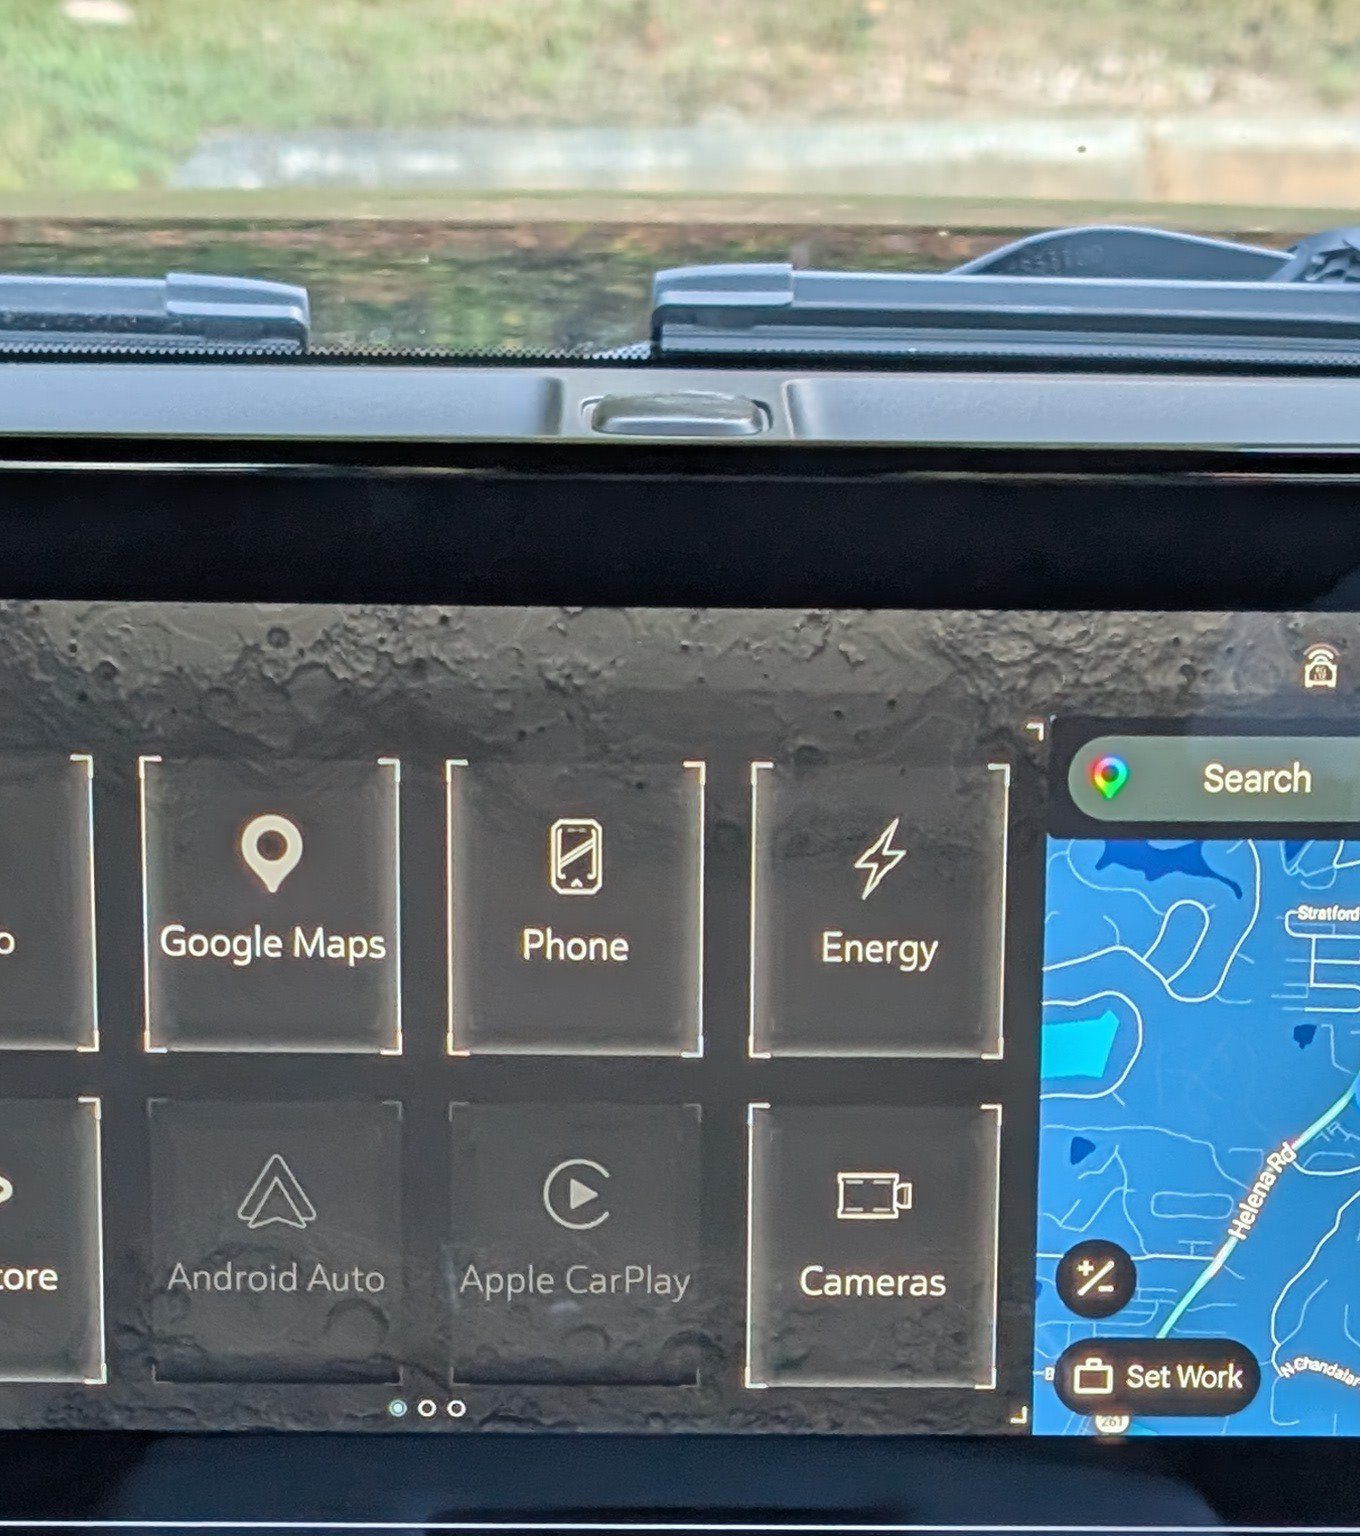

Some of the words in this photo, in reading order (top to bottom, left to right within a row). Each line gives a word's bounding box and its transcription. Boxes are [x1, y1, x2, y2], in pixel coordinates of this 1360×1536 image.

[1202, 761, 1313, 794] Search
[1297, 904, 1360, 922] Stratford
[159, 924, 283, 967] Google
[292, 926, 388, 967] Maps
[522, 927, 630, 962] Phone
[821, 930, 939, 972] Energy
[1227, 1171, 1277, 1240] Helena
[1266, 1141, 1298, 1173] Rd
[166, 1261, 298, 1293] Android
[306, 1263, 386, 1293] Auto
[459, 1264, 555, 1302] Apple
[565, 1264, 692, 1303] CarPlay
[799, 1264, 948, 1298] Cameras
[1126, 1363, 1172, 1389] Set
[1176, 1362, 1244, 1389] Work
[1280, 1362, 1296, 1378] N
